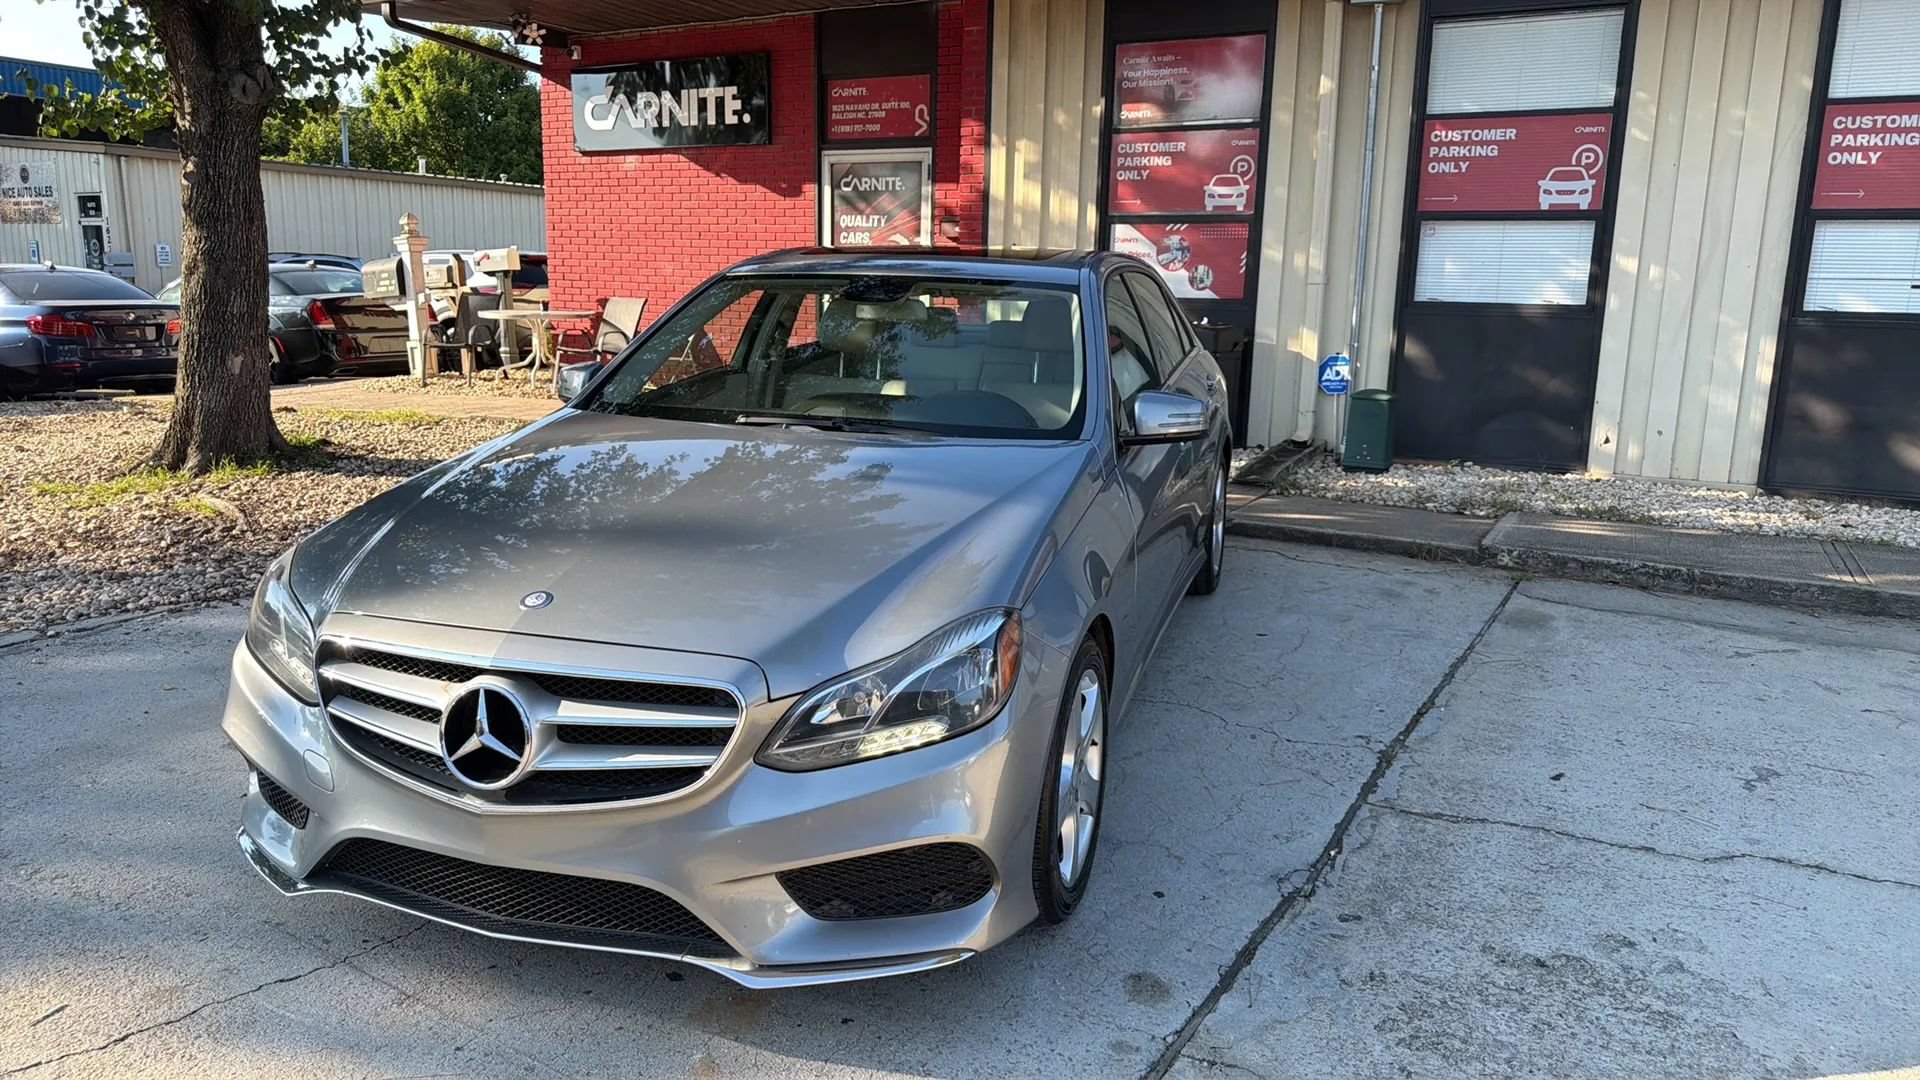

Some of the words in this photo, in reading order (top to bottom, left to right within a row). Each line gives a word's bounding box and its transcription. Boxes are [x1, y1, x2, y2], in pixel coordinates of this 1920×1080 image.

[1123, 56, 1149, 65] Carnite
[1151, 54, 1176, 63] Awaits
[1123, 69, 1142, 78] Your
[1143, 66, 1190, 78] Happiness,
[1122, 80, 1138, 89] Our
[1139, 77, 1174, 87] Mission!
[584, 85, 751, 131] CARNITE.
[845, 103, 870, 111] NAVAHO
[882, 101, 898, 110] SUITE
[832, 112, 857, 120] RALEIGH
[1832, 114, 1920, 129] CUSTOM
[1430, 128, 1517, 143] CUSTOMER
[1830, 132, 1920, 147] PARKING
[1118, 141, 1186, 154] CUSTOMER
[1429, 145, 1499, 158] PARKING
[1117, 155, 1172, 167] PARKING
[1827, 151, 1882, 165] ONLY
[1427, 161, 1470, 174] ONLY
[1116, 170, 1150, 181] ONLY
[840, 174, 905, 192] CARNITE.
[2, 187, 16, 199] NICE
[17, 186, 33, 198] AUTO
[33, 185, 54, 198] SALES
[840, 214, 888, 229] QUALITY
[840, 231, 872, 246] CARS,
